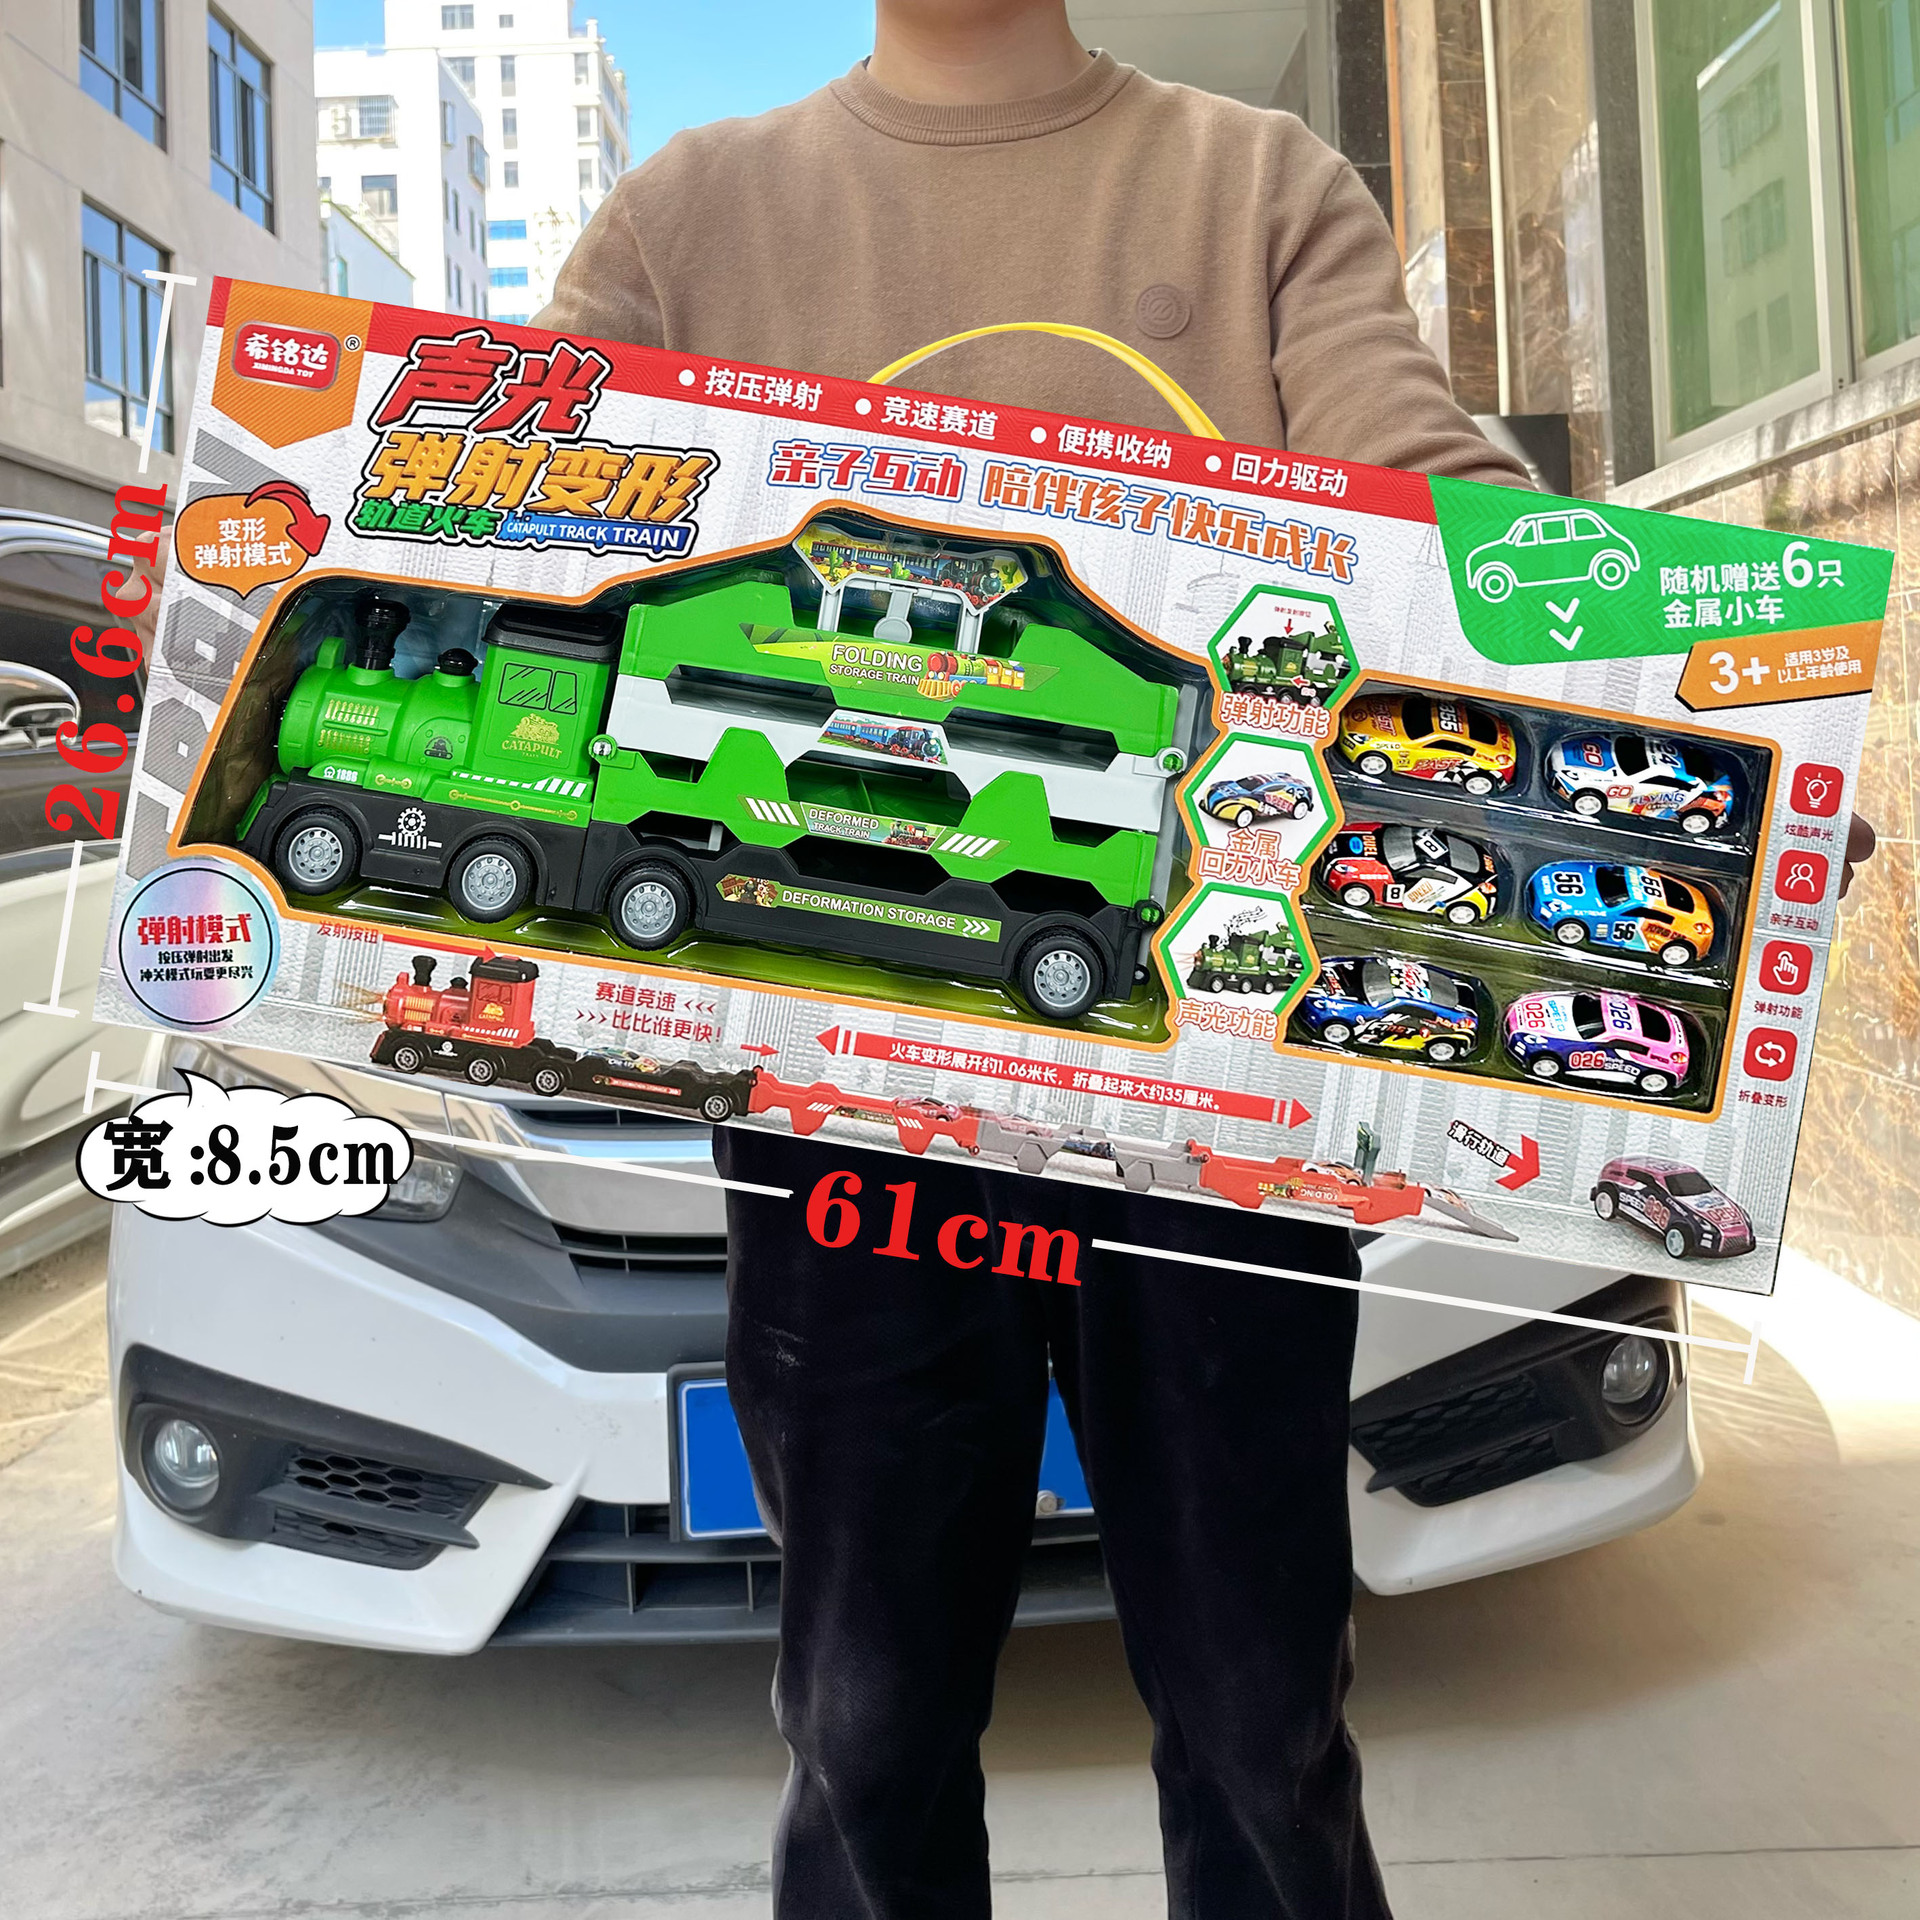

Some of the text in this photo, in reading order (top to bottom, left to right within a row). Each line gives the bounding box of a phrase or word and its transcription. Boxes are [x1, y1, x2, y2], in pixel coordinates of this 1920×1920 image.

[244, 332, 329, 370] 希铭达
[296, 368, 315, 378] TOY
[374, 333, 604, 434] 声光
[704, 366, 823, 413] 按压弹射
[883, 396, 999, 441] 竞速赛道
[1057, 424, 1172, 470] 便携收纳
[364, 430, 713, 525] 弹射变形
[1231, 453, 1349, 498] 回力驱动
[353, 499, 502, 539] 轨道火车
[771, 442, 1357, 582] 亲子互动 陪伴孩子快乐成长
[217, 517, 267, 543] 变形
[506, 521, 681, 548] CATAPULT TRACK TRAIN
[194, 541, 292, 569] 弹射模式
[1659, 541, 1845, 596] 随机赠送6只
[1663, 595, 1785, 629] 金属小车
[832, 644, 924, 672] FOLDING
[1783, 645, 1850, 668] 适用3岁及
[829, 664, 920, 686] STORAGE TRAIN
[1708, 651, 1771, 695] 3+
[1777, 659, 1862, 684] 以上年龄使用
[1221, 693, 1331, 738] 弹射功能
[501, 740, 563, 760] CATAPULT
[1606, 784, 1634, 799] GO
[1629, 791, 1686, 806] FLYING
[808, 808, 880, 830] DEFORMED
[813, 821, 871, 840] TRACK TRAIN
[1228, 829, 1280, 860] 金属
[1784, 824, 1834, 842] 炫酷声光
[1390, 886, 1401, 899] 8
[1554, 871, 1586, 897] 56
[782, 889, 956, 930] DEFORMATION STORAGE
[1769, 912, 1819, 931] 亲子互动
[137, 914, 253, 945] 弹射模式
[317, 920, 379, 944] 发射按钮
[1612, 921, 1636, 941] 56
[158, 949, 234, 965] 按压弹射出发
[595, 981, 677, 1011] 赛道竞速
[1176, 998, 1279, 1040] 声光功能
[1525, 1002, 1546, 1029] 026
[1754, 1000, 1804, 1020] 弹射功能
[1569, 1051, 1605, 1069] 026
[1604, 1061, 1641, 1077] SPEED
[1738, 1089, 1789, 1108] 折叠变形
